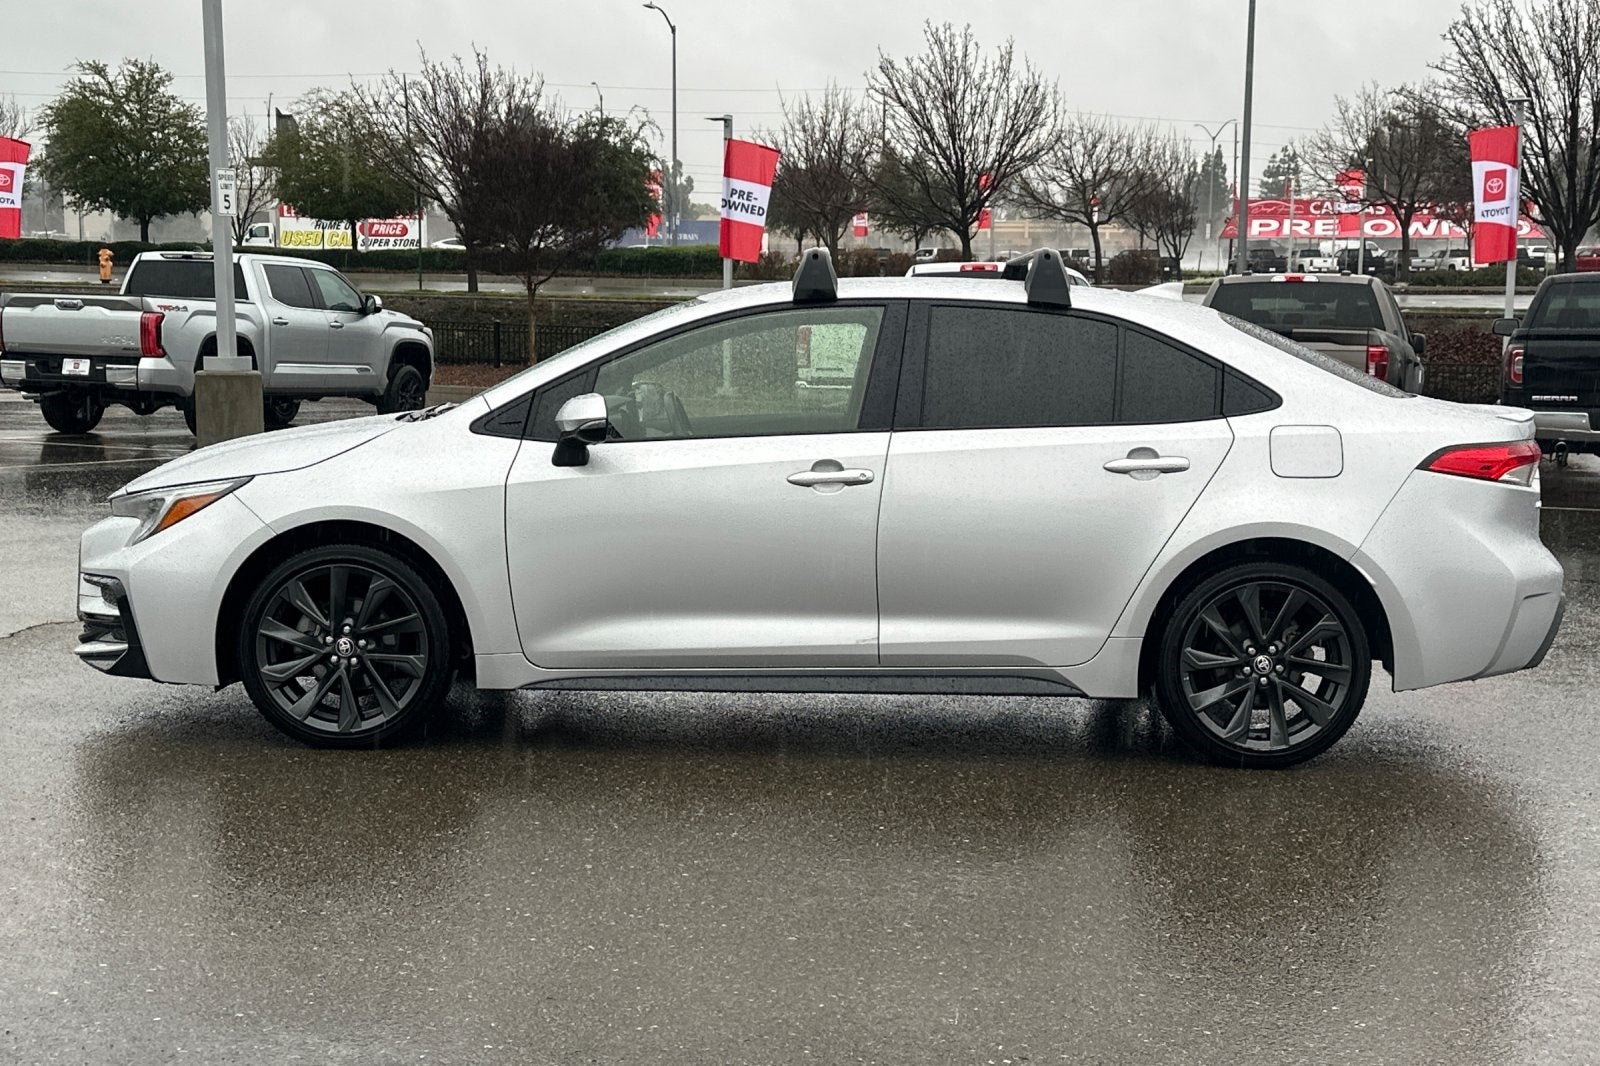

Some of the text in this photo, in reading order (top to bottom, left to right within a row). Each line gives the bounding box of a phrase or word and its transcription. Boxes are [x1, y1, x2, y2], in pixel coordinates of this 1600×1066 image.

[224, 194, 231, 209] 5
[730, 187, 758, 202] PRE-
[372, 223, 404, 235] PRICE
[1251, 219, 1340, 236] PRE
[280, 230, 323, 247] USED
